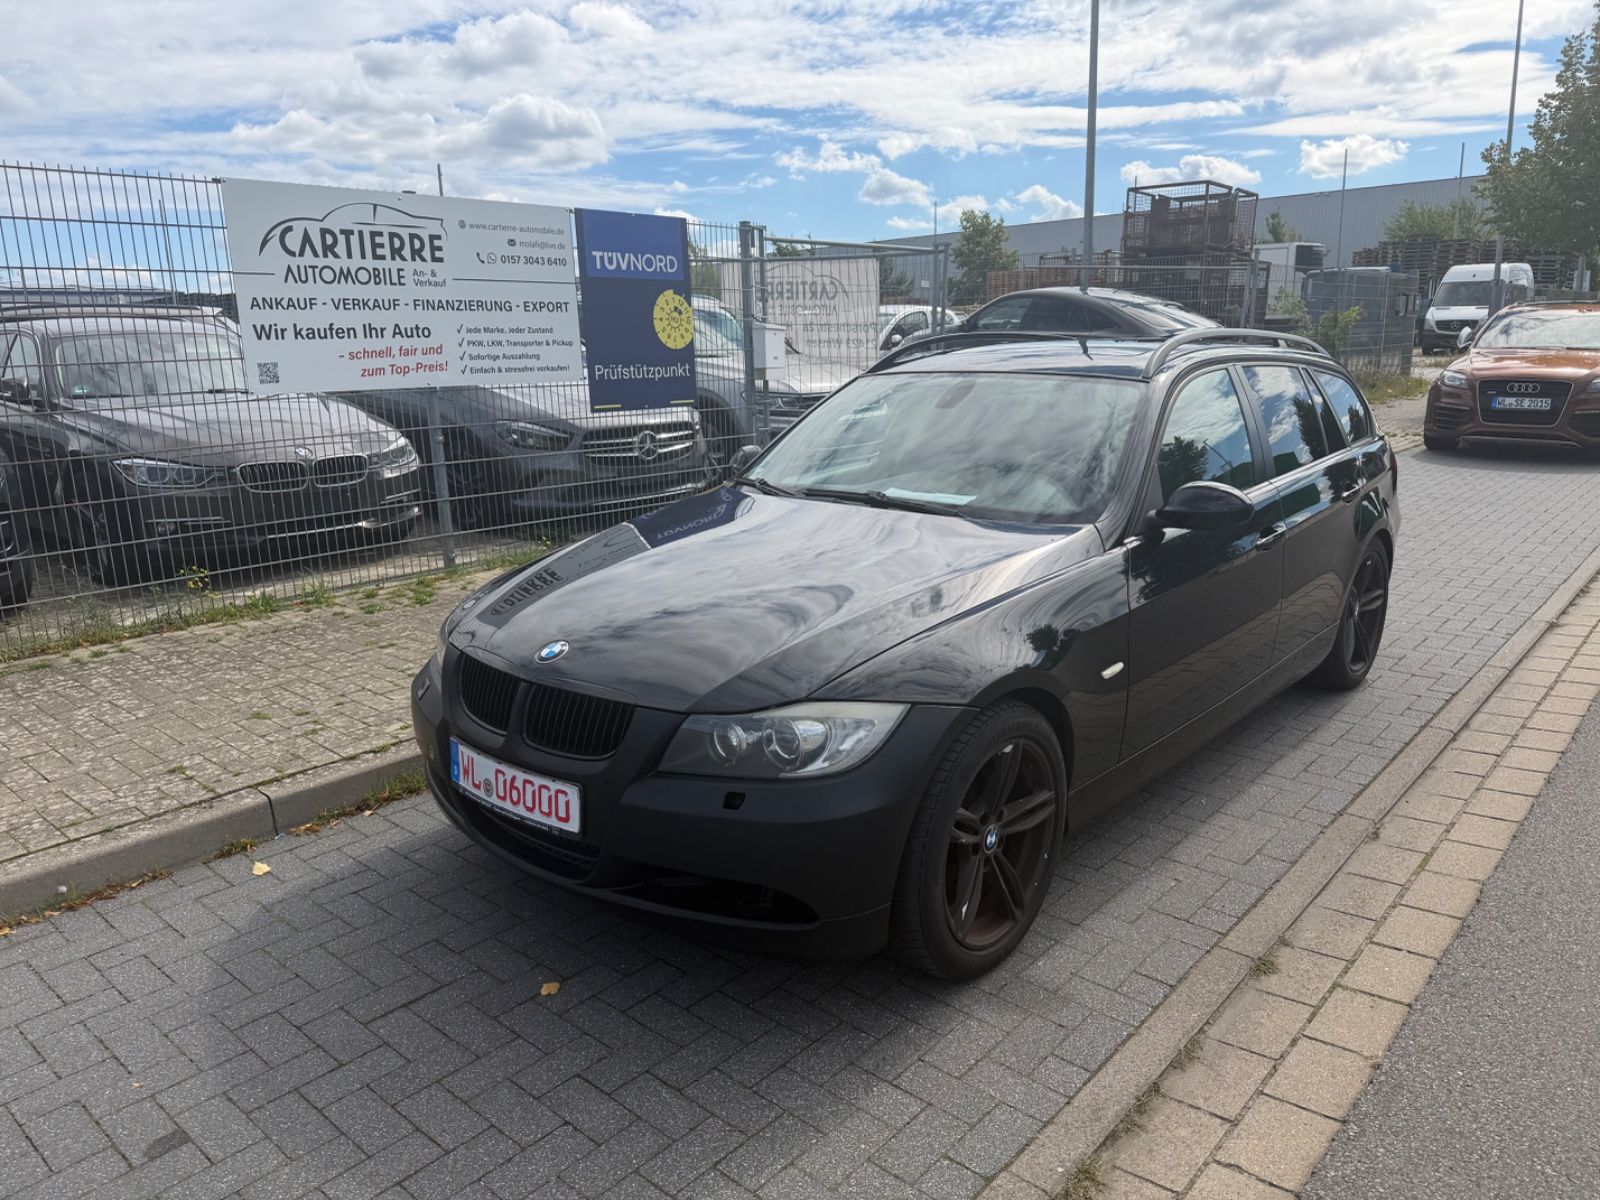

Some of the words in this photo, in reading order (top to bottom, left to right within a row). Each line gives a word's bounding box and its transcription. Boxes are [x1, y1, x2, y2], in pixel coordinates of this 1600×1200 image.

[279, 225, 444, 264] CARTIERRE
[500, 254, 520, 264] 0157
[523, 256, 545, 266] 3043
[548, 257, 567, 267] 6410
[284, 264, 406, 287] AUTOMOBILE
[412, 269, 428, 278] An-
[430, 269, 437, 278] &
[414, 278, 447, 287] Verkauf
[250, 296, 318, 311] ANKAUF
[331, 298, 401, 311] VERKAUF
[413, 299, 513, 312] FINANZIERUNG
[524, 301, 569, 314] EXPORT
[252, 324, 288, 341] Wir
[292, 323, 357, 340] kaufen
[363, 323, 386, 339] Ihr
[392, 324, 432, 339] Auto
[528, 326, 554, 334] Zustand
[467, 340, 486, 348] PKW,
[487, 340, 505, 348] LKW,
[506, 340, 544, 348] Transporter
[552, 339, 574, 347] Pickup
[348, 346, 396, 361] schnell,
[399, 346, 418, 358] fair
[421, 344, 443, 355] und
[468, 353, 500, 361] Sofortige
[502, 353, 541, 361] Auszahlung
[361, 366, 385, 378] zum
[389, 362, 448, 377] Top-Preis!
[470, 366, 496, 374] Einfach
[504, 365, 535, 373] stressfrei
[536, 364, 570, 373] verkaufen!
[595, 362, 690, 381] Prüfstützpunkt
[1497, 398, 1508, 407] WL
[1514, 399, 1525, 407] SE
[1528, 399, 1550, 408] 2015
[460, 750, 482, 791] WL
[495, 768, 571, 824] 06000
